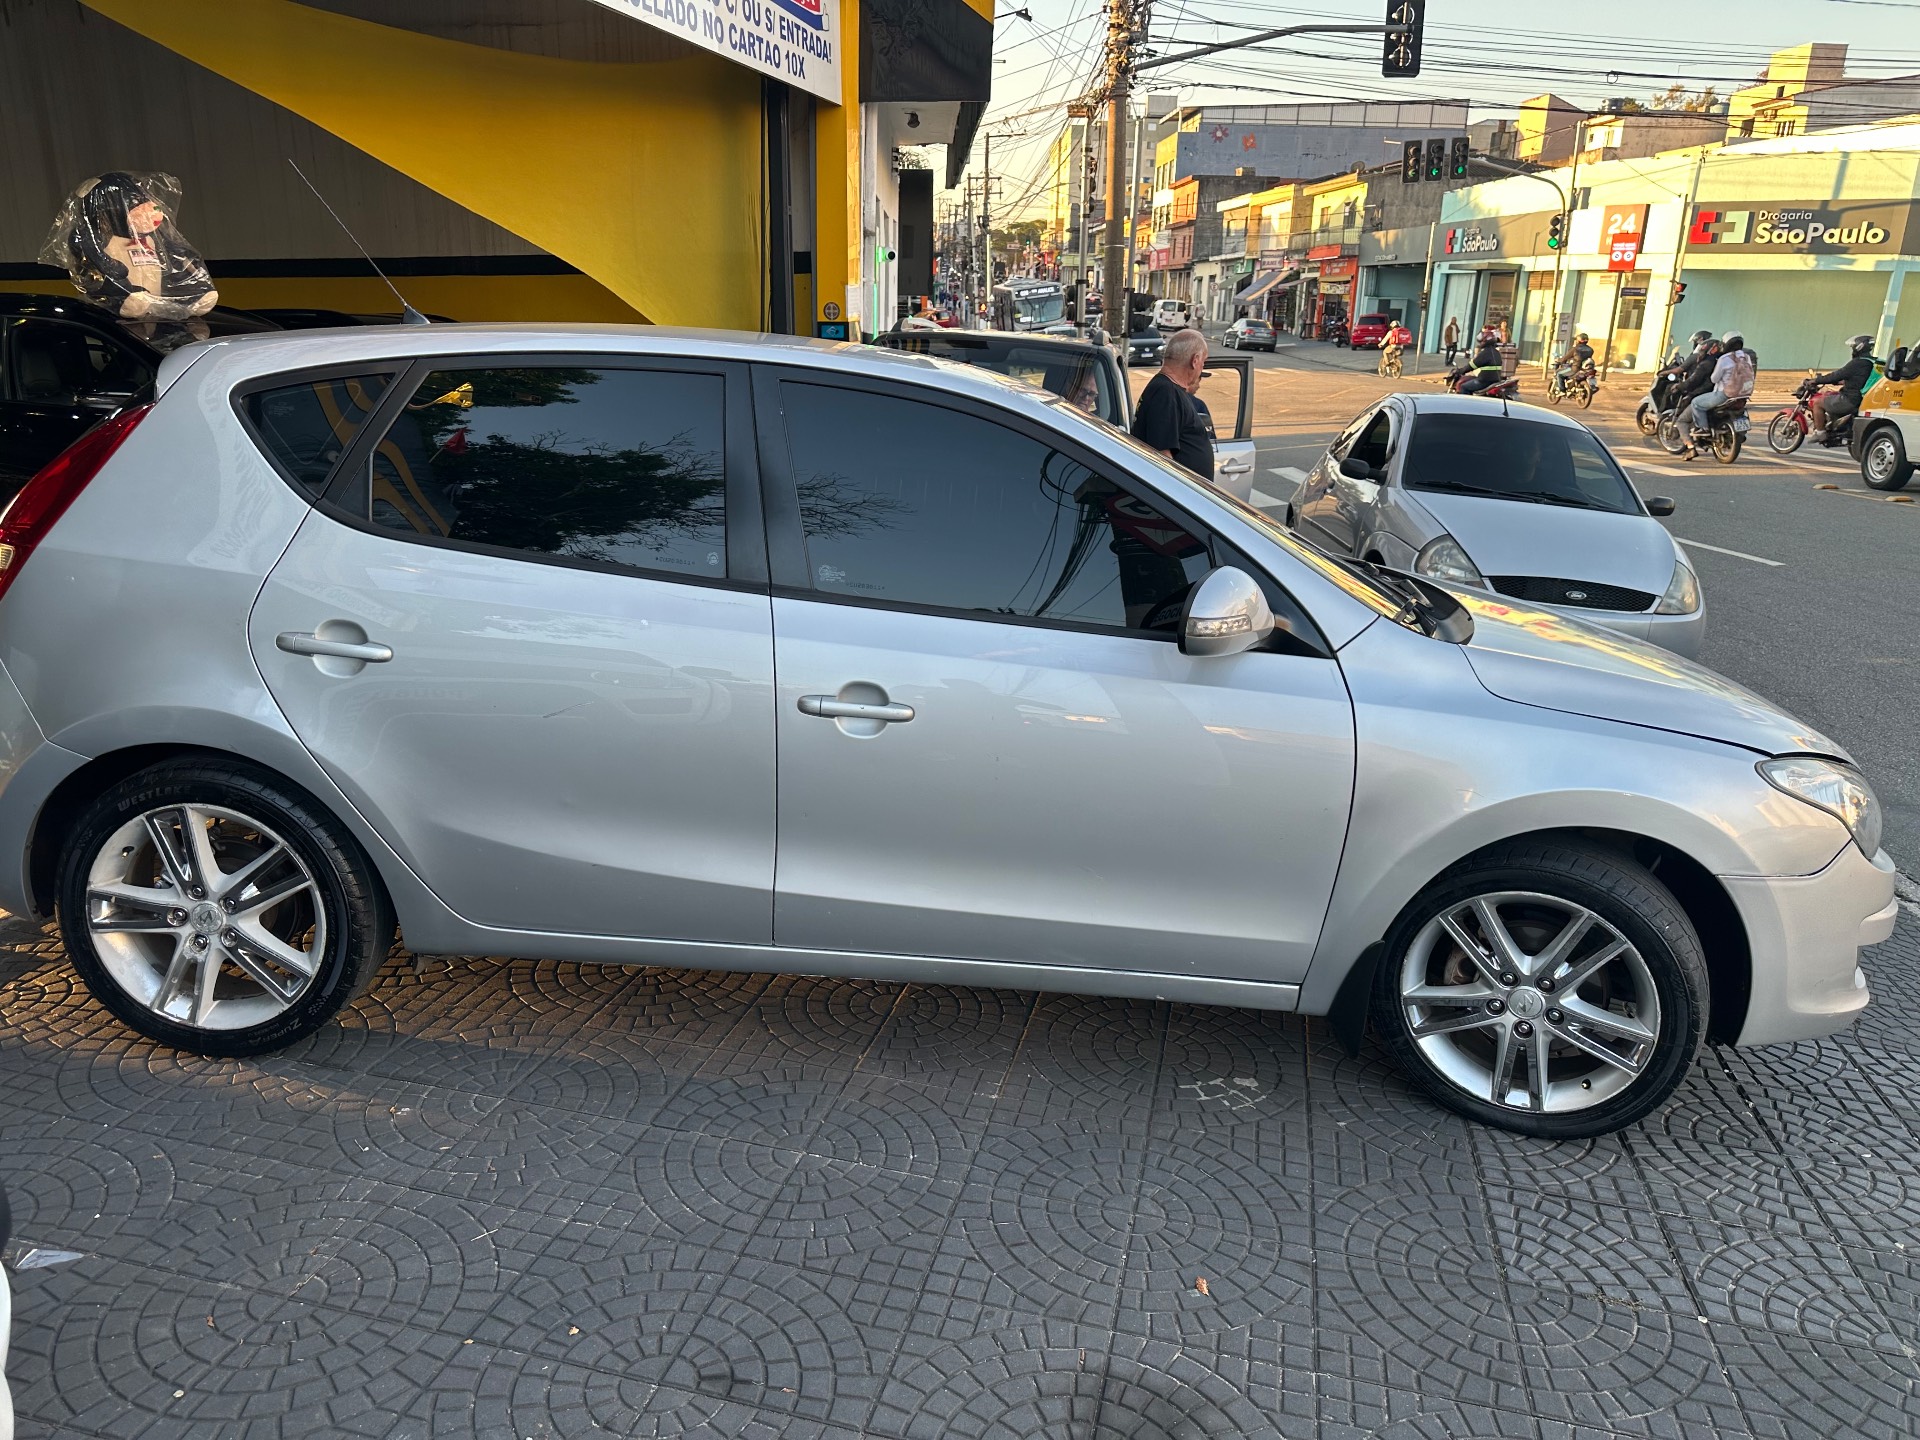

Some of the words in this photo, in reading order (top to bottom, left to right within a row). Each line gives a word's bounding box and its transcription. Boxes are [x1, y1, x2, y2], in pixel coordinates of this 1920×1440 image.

[702, 8, 725, 44] NO
[728, 23, 781, 69] CARTAO
[785, 49, 806, 80] 10X
[742, 0, 761, 27] OU
[765, 7, 776, 35] S/
[779, 14, 833, 65] ENTRADA!
[1607, 213, 1637, 235] 24
[1758, 210, 1813, 222] Drogaria
[1754, 221, 1885, 244] SãoPaulo
